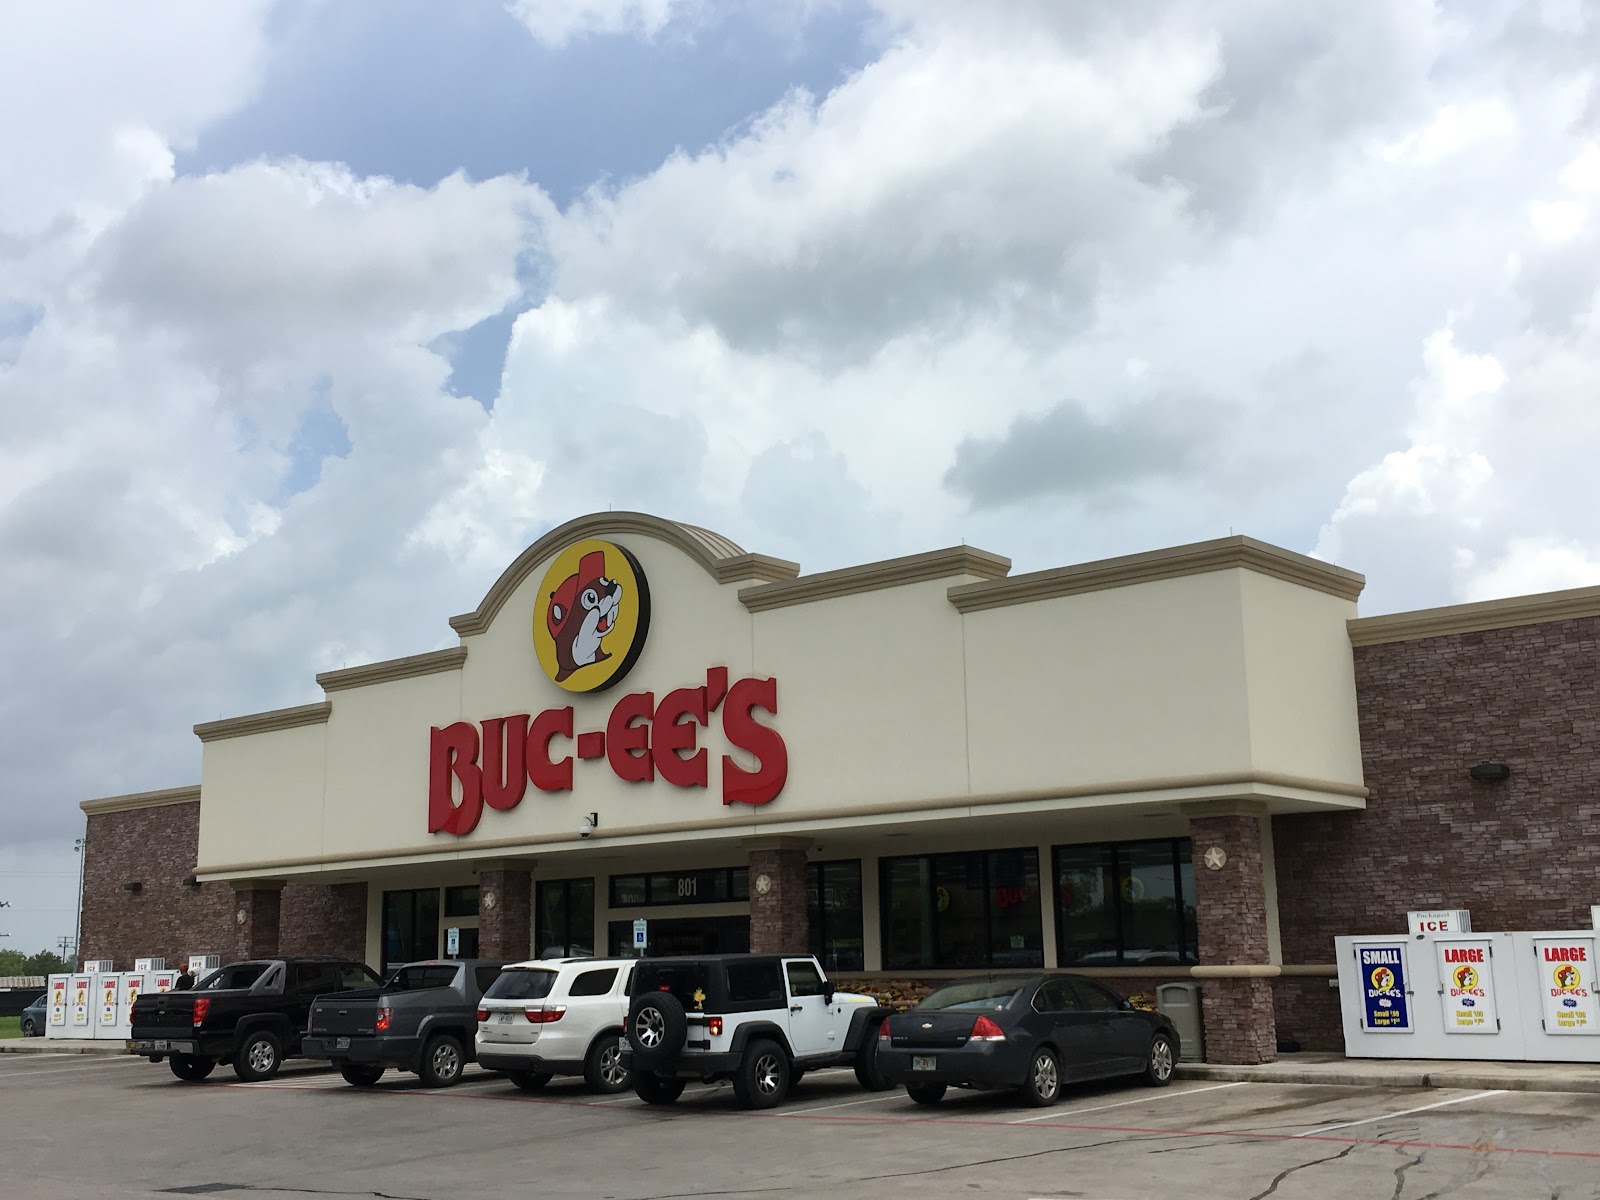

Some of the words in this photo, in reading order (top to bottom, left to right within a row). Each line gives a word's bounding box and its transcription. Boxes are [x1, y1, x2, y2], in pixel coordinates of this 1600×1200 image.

[428, 666, 788, 835] BUC-EE'S
[677, 877, 697, 897] 801
[1419, 920, 1449, 932] ICE
[1362, 950, 1400, 965] SMALL
[1444, 948, 1484, 963] LARGE
[1544, 947, 1587, 962] LARGE
[1374, 1018, 1390, 1026] Large
